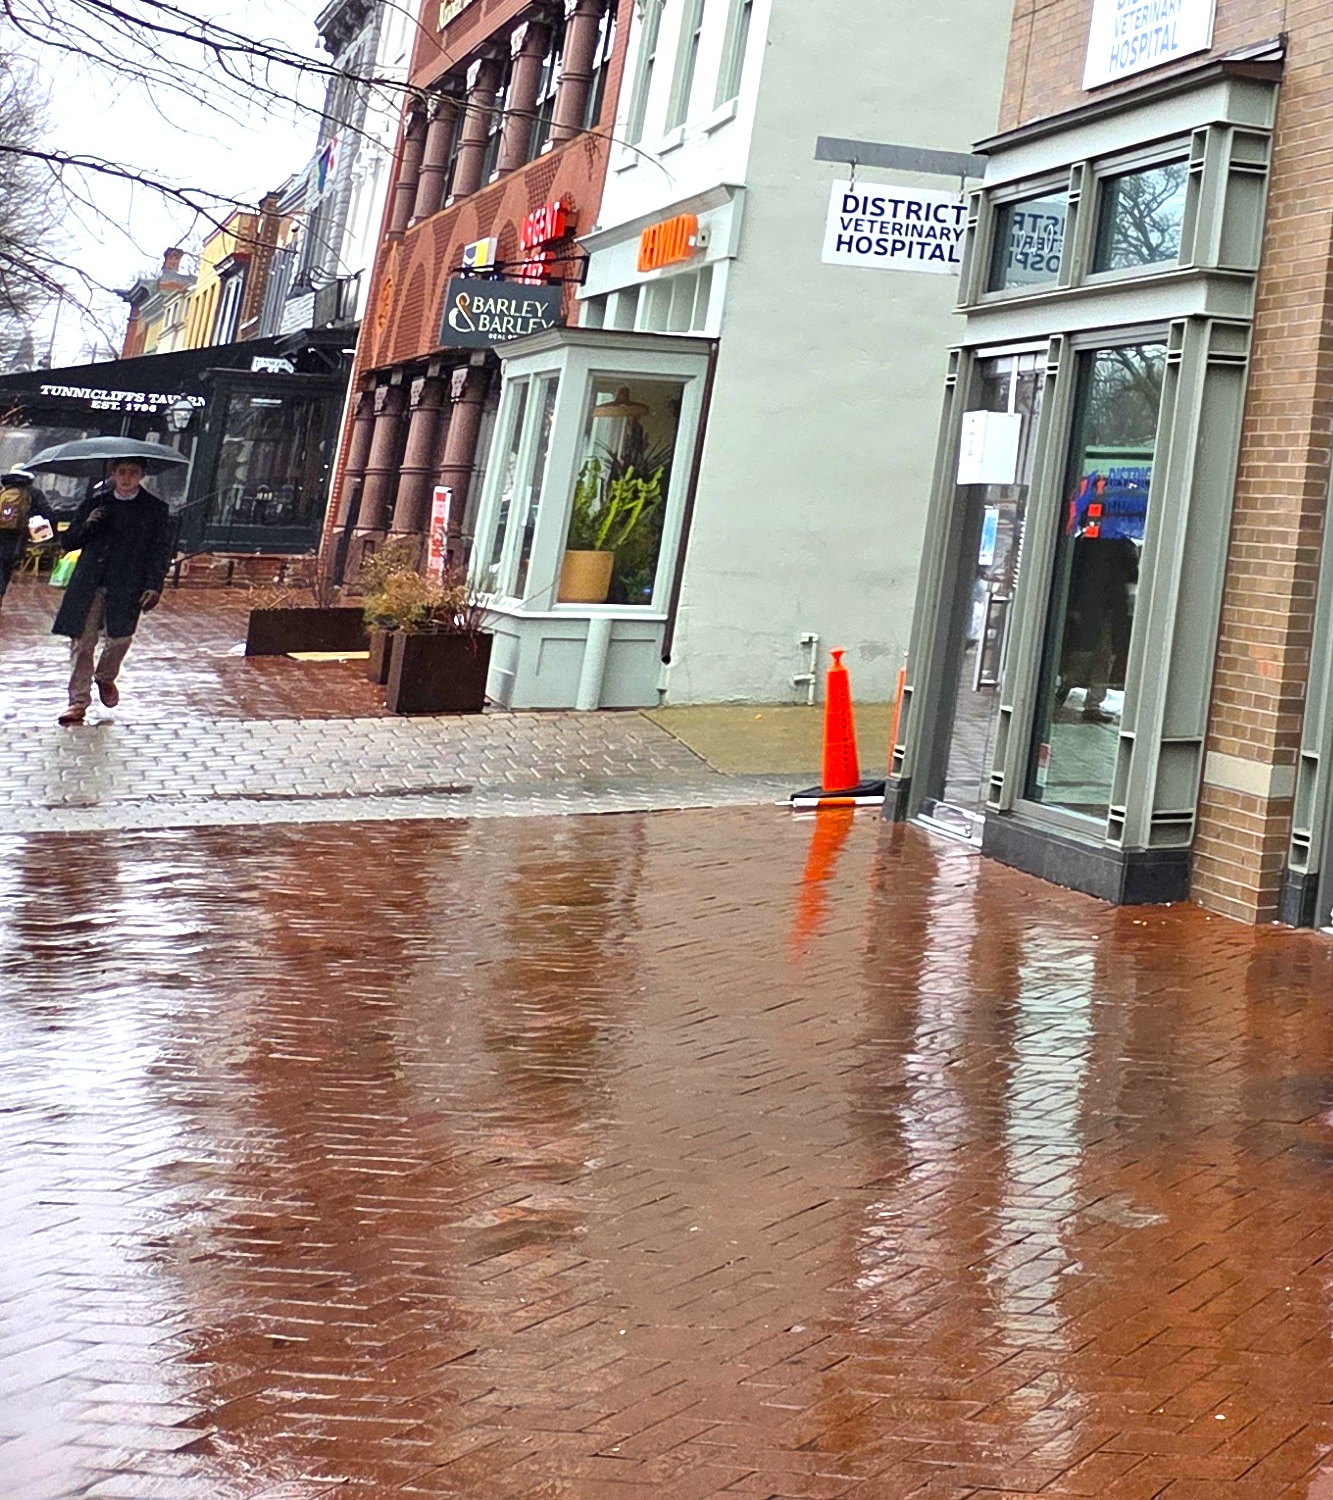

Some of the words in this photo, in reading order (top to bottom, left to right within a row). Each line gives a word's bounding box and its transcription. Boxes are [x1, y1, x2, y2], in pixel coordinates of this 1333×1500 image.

[1108, 20, 1179, 74] HOSPITAL
[842, 194, 968, 225] DISTRICT
[840, 216, 965, 242] VETERINARY
[836, 233, 961, 263] HOSPITAL
[472, 296, 549, 318] BARLEY
[40, 384, 146, 403] TUNNICLIFFS
[148, 393, 206, 407] TAVRN
[90, 400, 121, 411] EST.
